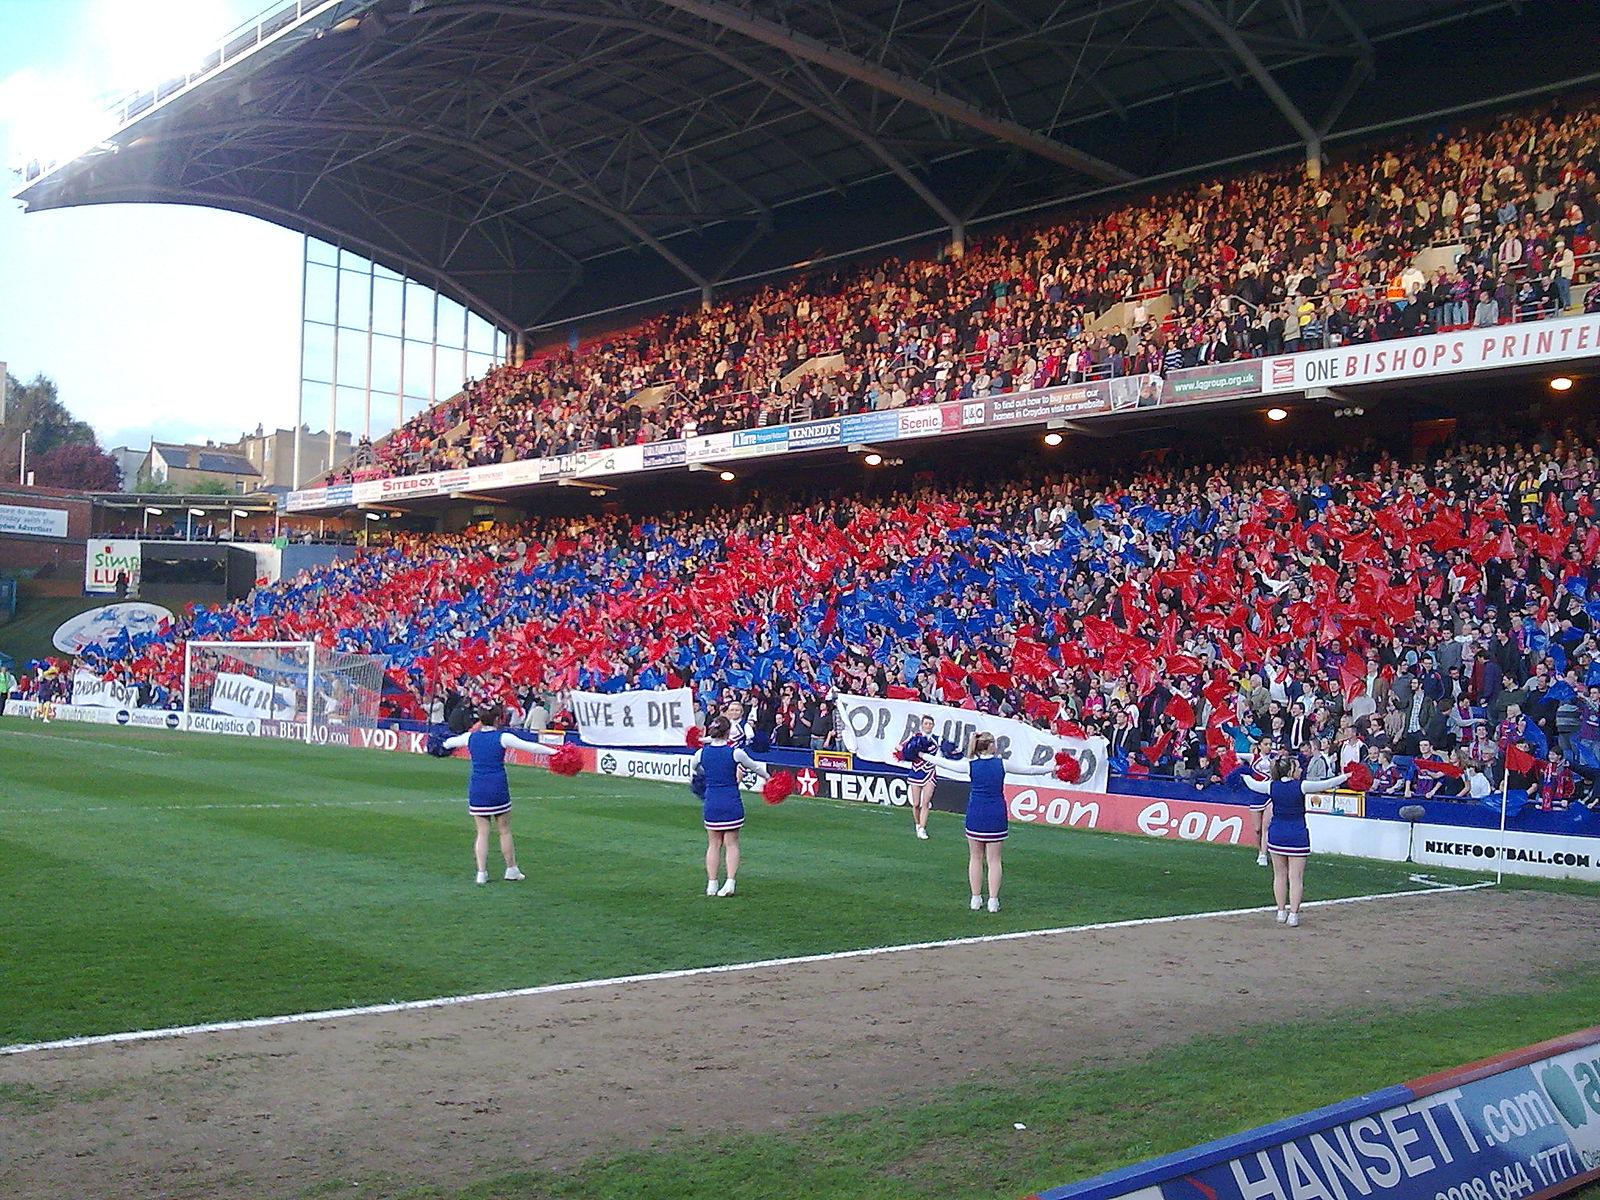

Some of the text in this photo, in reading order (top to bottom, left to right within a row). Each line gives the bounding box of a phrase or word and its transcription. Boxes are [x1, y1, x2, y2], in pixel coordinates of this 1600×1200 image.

[1305, 325, 1600, 382] ONE BISHOPS PRINTE
[901, 417, 939, 430] Scenic
[1023, 407, 1051, 418] Croydon
[788, 423, 841, 440] KENNEDY'S
[382, 477, 436, 492] SITEBOX
[215, 679, 255, 706] PALACE
[194, 717, 210, 730] GAC
[211, 719, 244, 734] Logistics
[576, 700, 684, 730] LIVE & DIE
[825, 772, 932, 809] TEXAC
[1425, 840, 1590, 868] NIKEFOOTBALL.COM
[1490, 1161, 1536, 1200] 644
[1530, 1142, 1578, 1187] 1777
